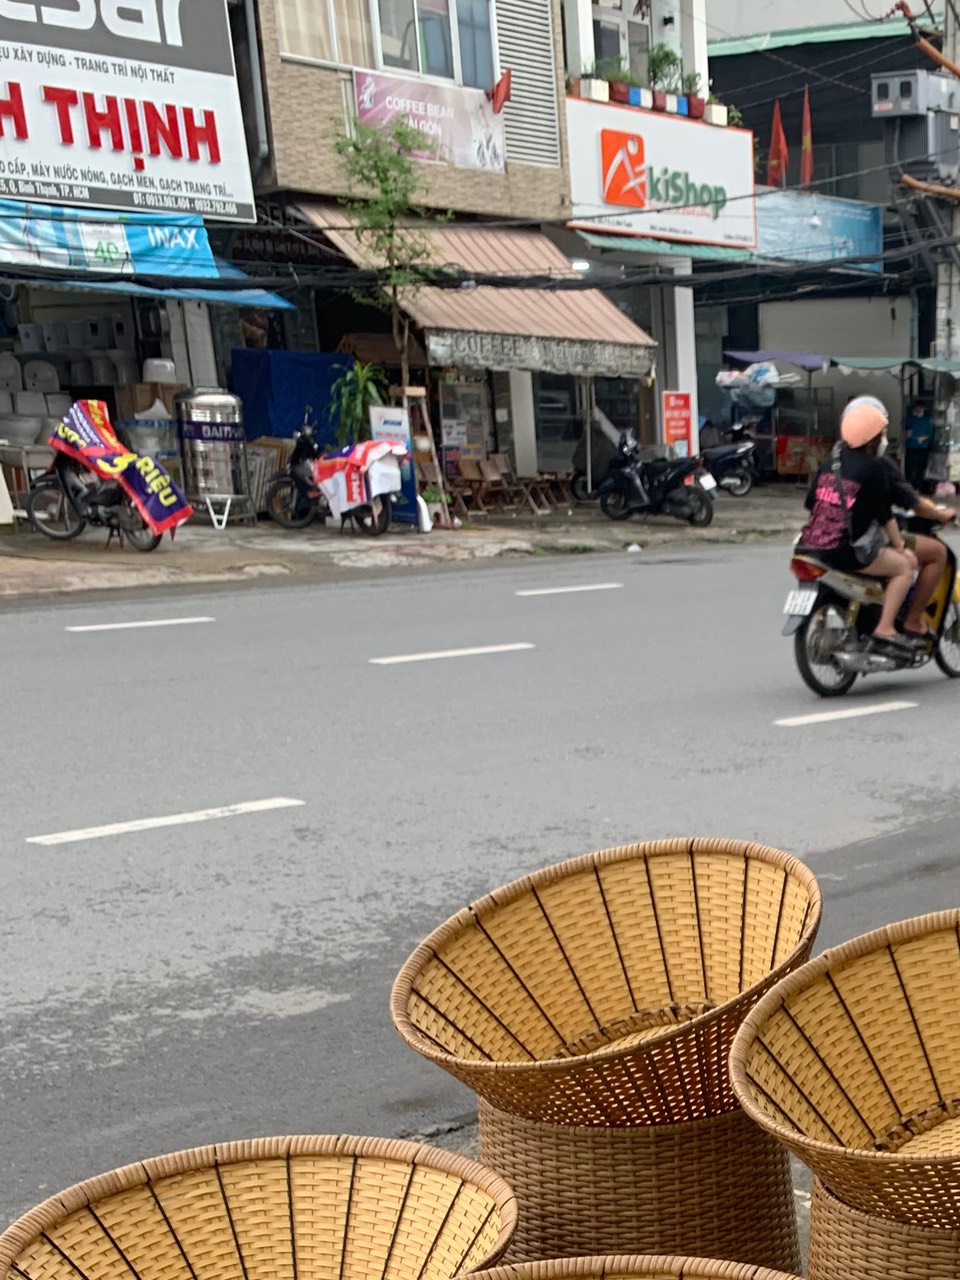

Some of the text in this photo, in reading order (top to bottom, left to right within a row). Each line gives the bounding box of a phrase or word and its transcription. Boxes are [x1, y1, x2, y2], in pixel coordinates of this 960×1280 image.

[13, 47, 33, 62] XÂY
[37, 53, 66, 68] DỰNG
[74, 57, 109, 74] TRANG
[111, 63, 128, 77] TRÍ
[130, 66, 148, 83] NỘI
[150, 68, 175, 84] THẤT
[385, 96, 454, 120] COFFEE BEAN
[41, 85, 221, 171] THỊNH
[31, 160, 51, 178] MÁY
[53, 163, 79, 181] NƯỚC
[110, 171, 135, 190] GẠCH
[159, 178, 182, 196] GẠCH
[184, 181, 211, 197] TRANG
[147, 226, 201, 250] INAX
